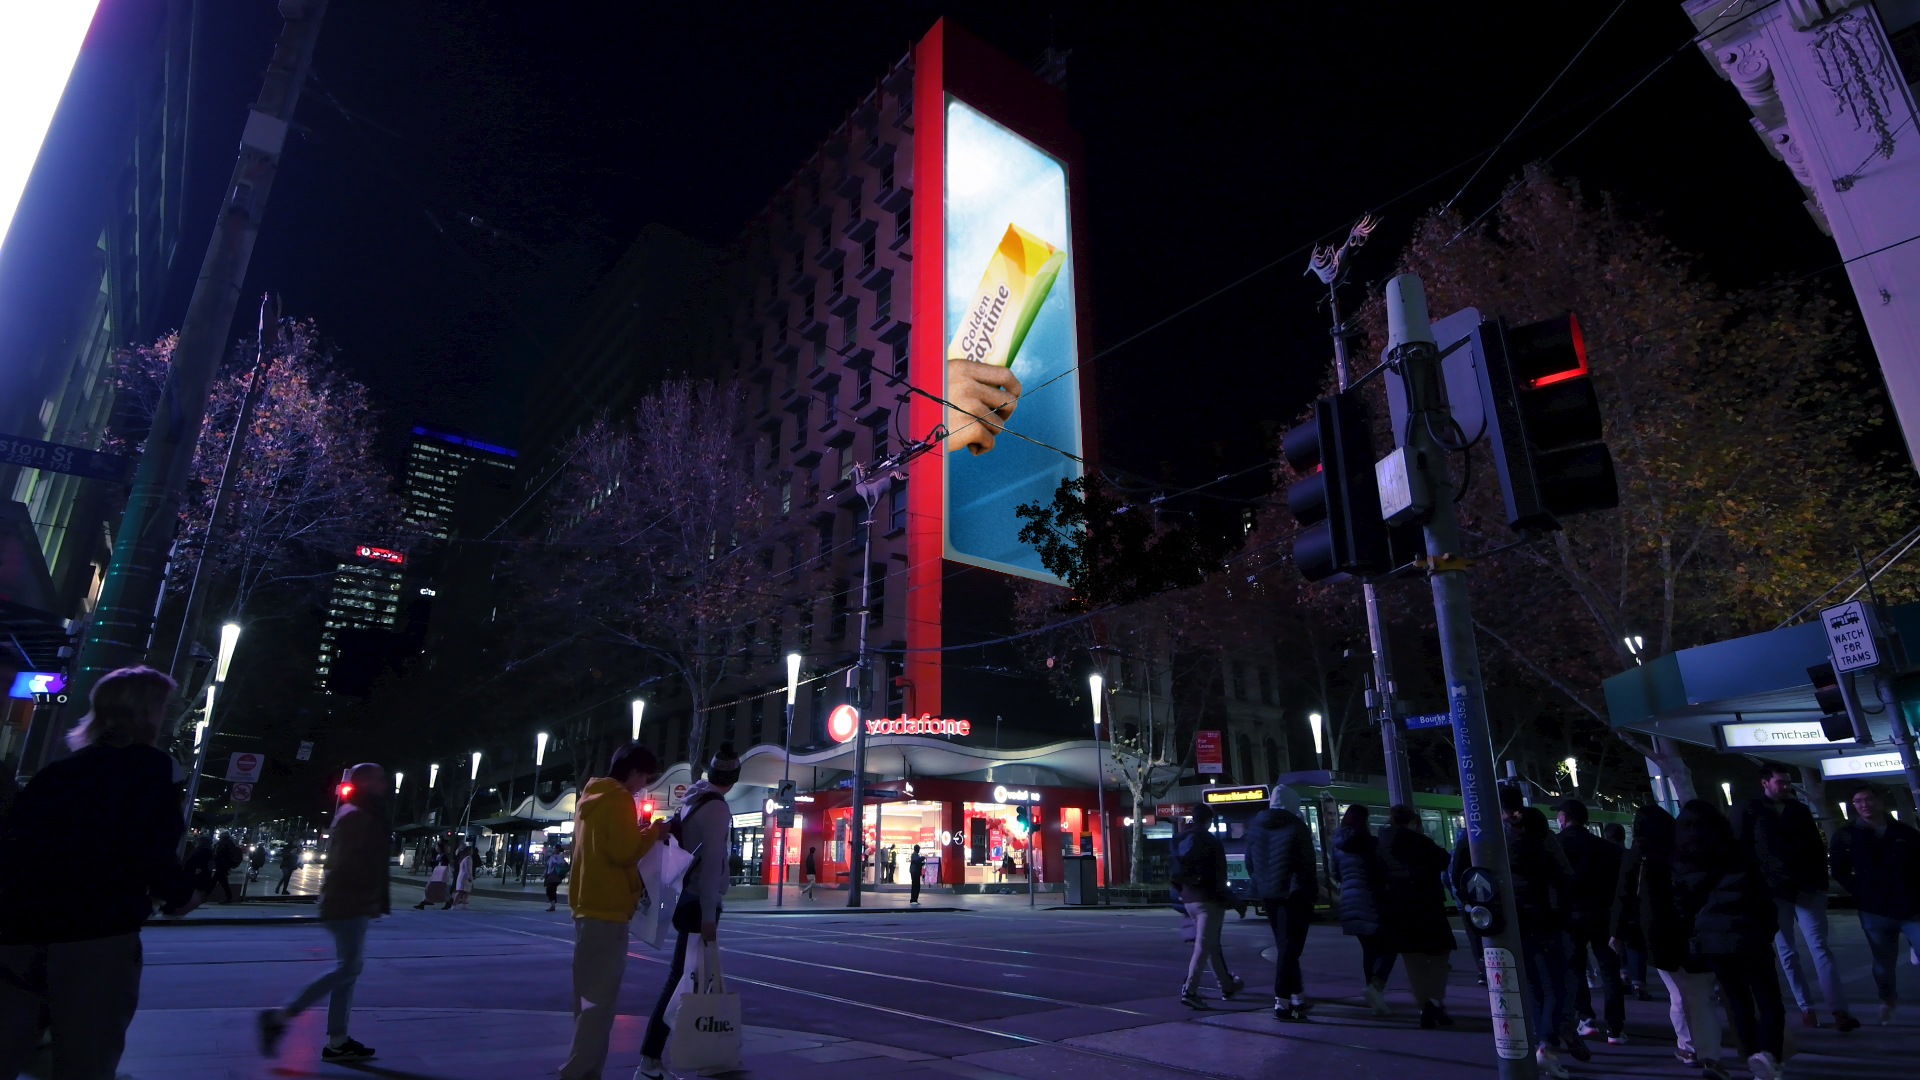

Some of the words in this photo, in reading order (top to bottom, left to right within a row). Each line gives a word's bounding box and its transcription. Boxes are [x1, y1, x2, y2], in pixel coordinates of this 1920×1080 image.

[961, 295, 991, 352] Golden
[5, 453, 32, 465] 225
[49, 461, 71, 472] 179
[51, 446, 75, 465] St
[1833, 628, 1865, 644] WATCH
[1843, 641, 1862, 653] FOR
[1841, 650, 1871, 665] TRAMS
[1419, 713, 1446, 724] Bourke
[1456, 701, 1467, 719] 352
[865, 712, 971, 736] vodafone
[1460, 727, 1471, 746] 270
[1771, 729, 1821, 740] michael
[1461, 754, 1474, 769] St
[1864, 759, 1901, 768] micha
[1466, 773, 1482, 822] Bourke
[694, 1016, 734, 1033] Glue.
